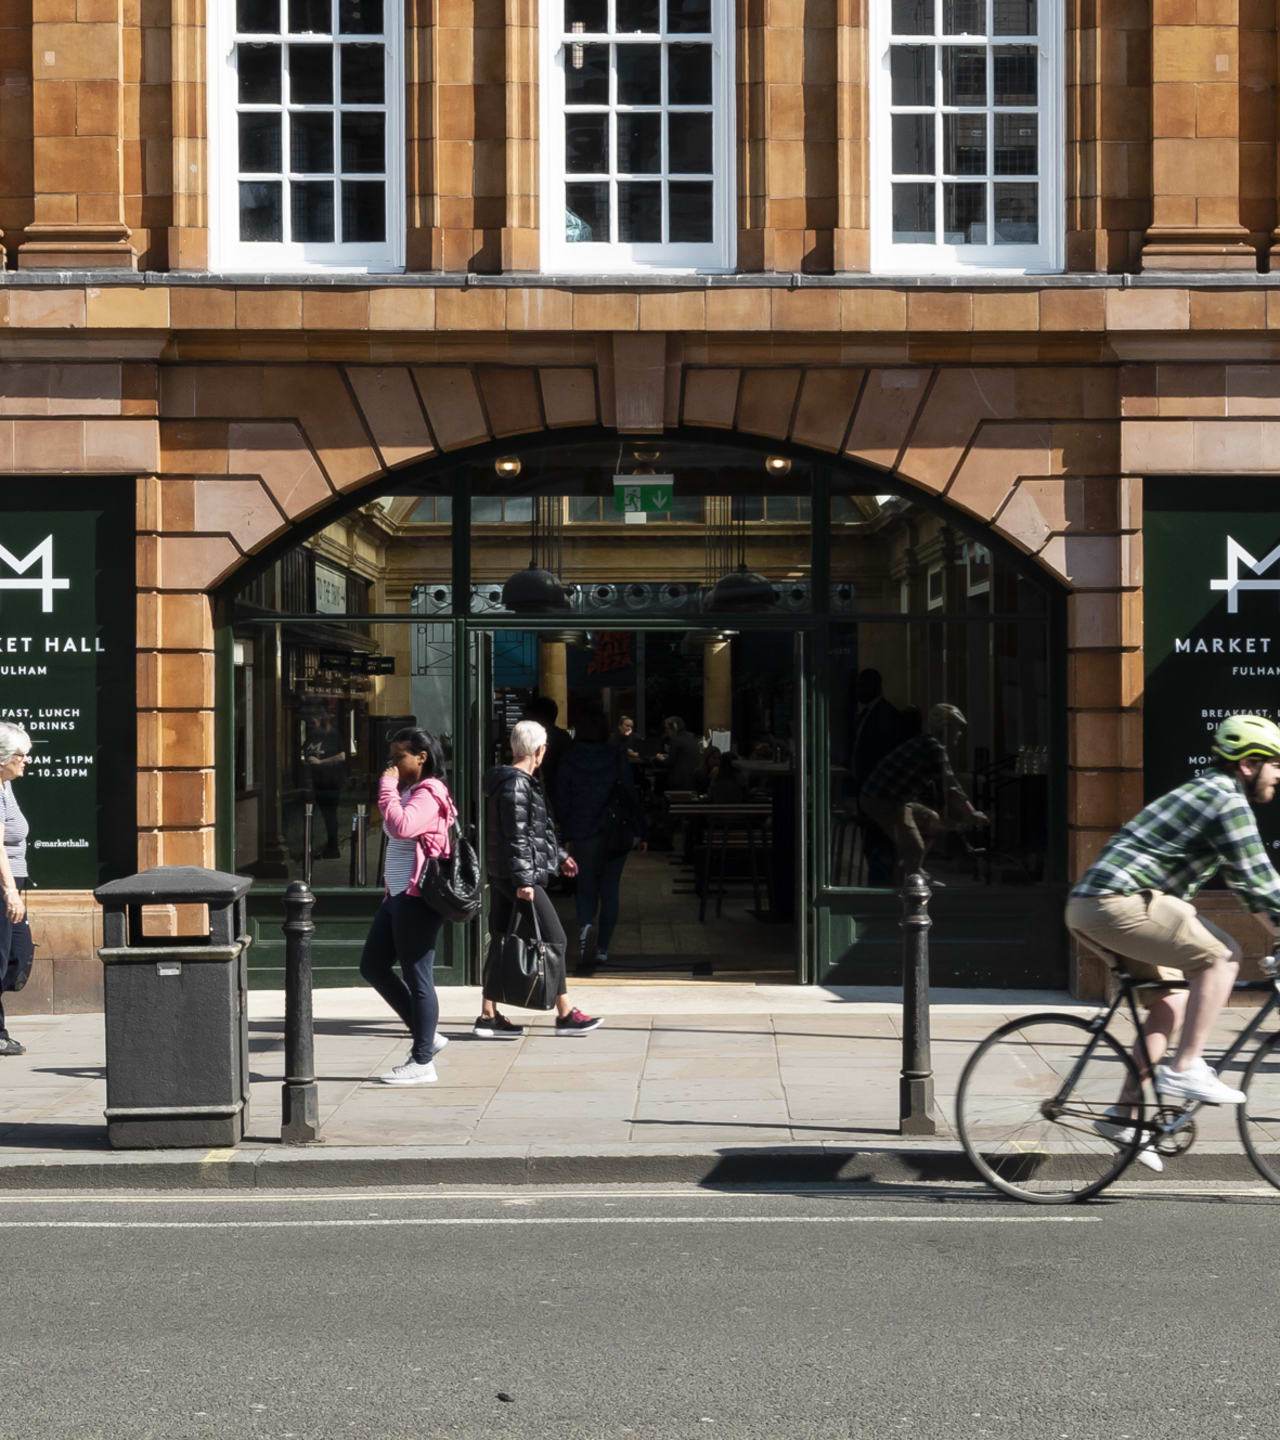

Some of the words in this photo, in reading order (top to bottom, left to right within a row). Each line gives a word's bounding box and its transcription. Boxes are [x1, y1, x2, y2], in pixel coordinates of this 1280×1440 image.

[45, 636, 105, 653] HALL
[1175, 637, 1271, 653] MARKET
[38, 708, 80, 718] LUNCH
[30, 721, 76, 731] DRINKS
[65, 755, 94, 765] 11PM
[38, 768, 88, 778] 10.30PM
[34, 838, 89, 850] @markethalls
